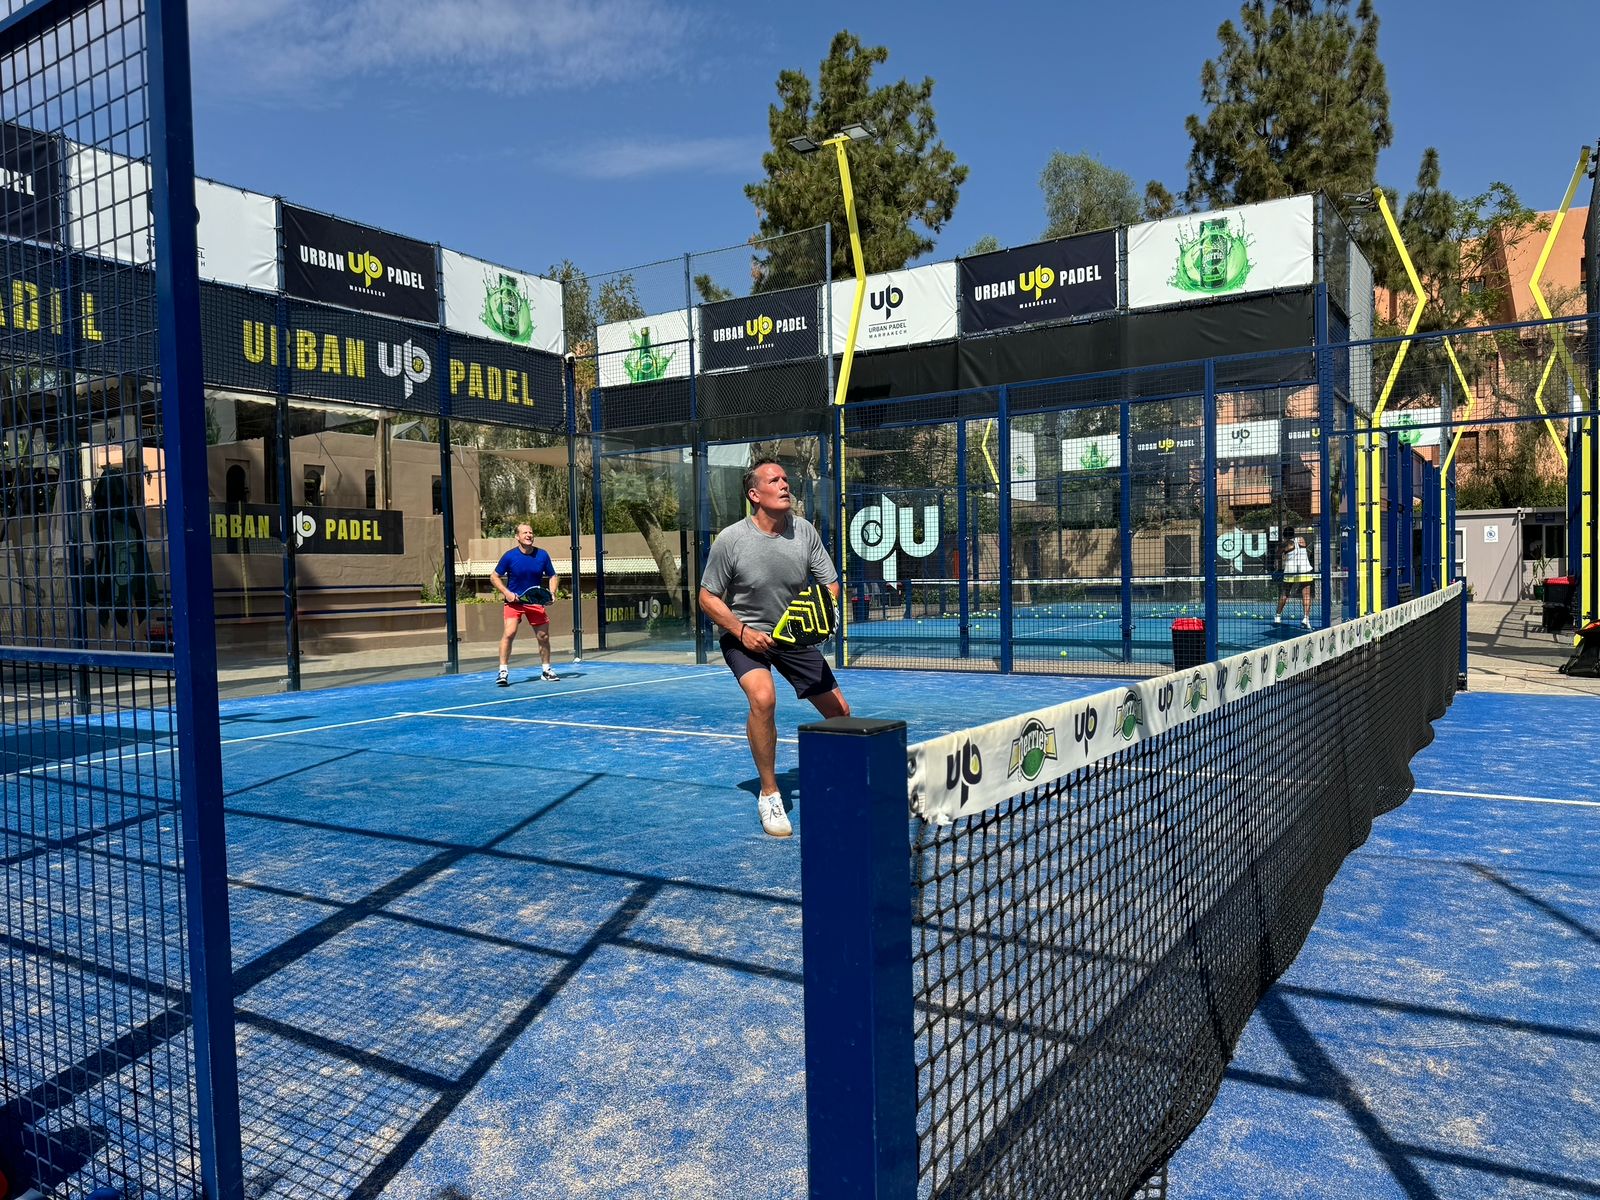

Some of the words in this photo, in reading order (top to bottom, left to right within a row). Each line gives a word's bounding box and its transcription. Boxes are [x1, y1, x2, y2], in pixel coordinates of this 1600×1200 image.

[300, 244, 345, 272] URBAN
[387, 266, 425, 290] PADEL
[974, 279, 1016, 302] URBAN
[1059, 264, 1102, 287] PADEL
[713, 325, 744, 342] URBAN
[776, 316, 808, 333] PADEL
[868, 325, 888, 333] URBAN
[888, 322, 907, 330] PADEL
[449, 358, 534, 406] PADEL
[210, 513, 270, 538] RBAN
[325, 518, 382, 541] PADEL
